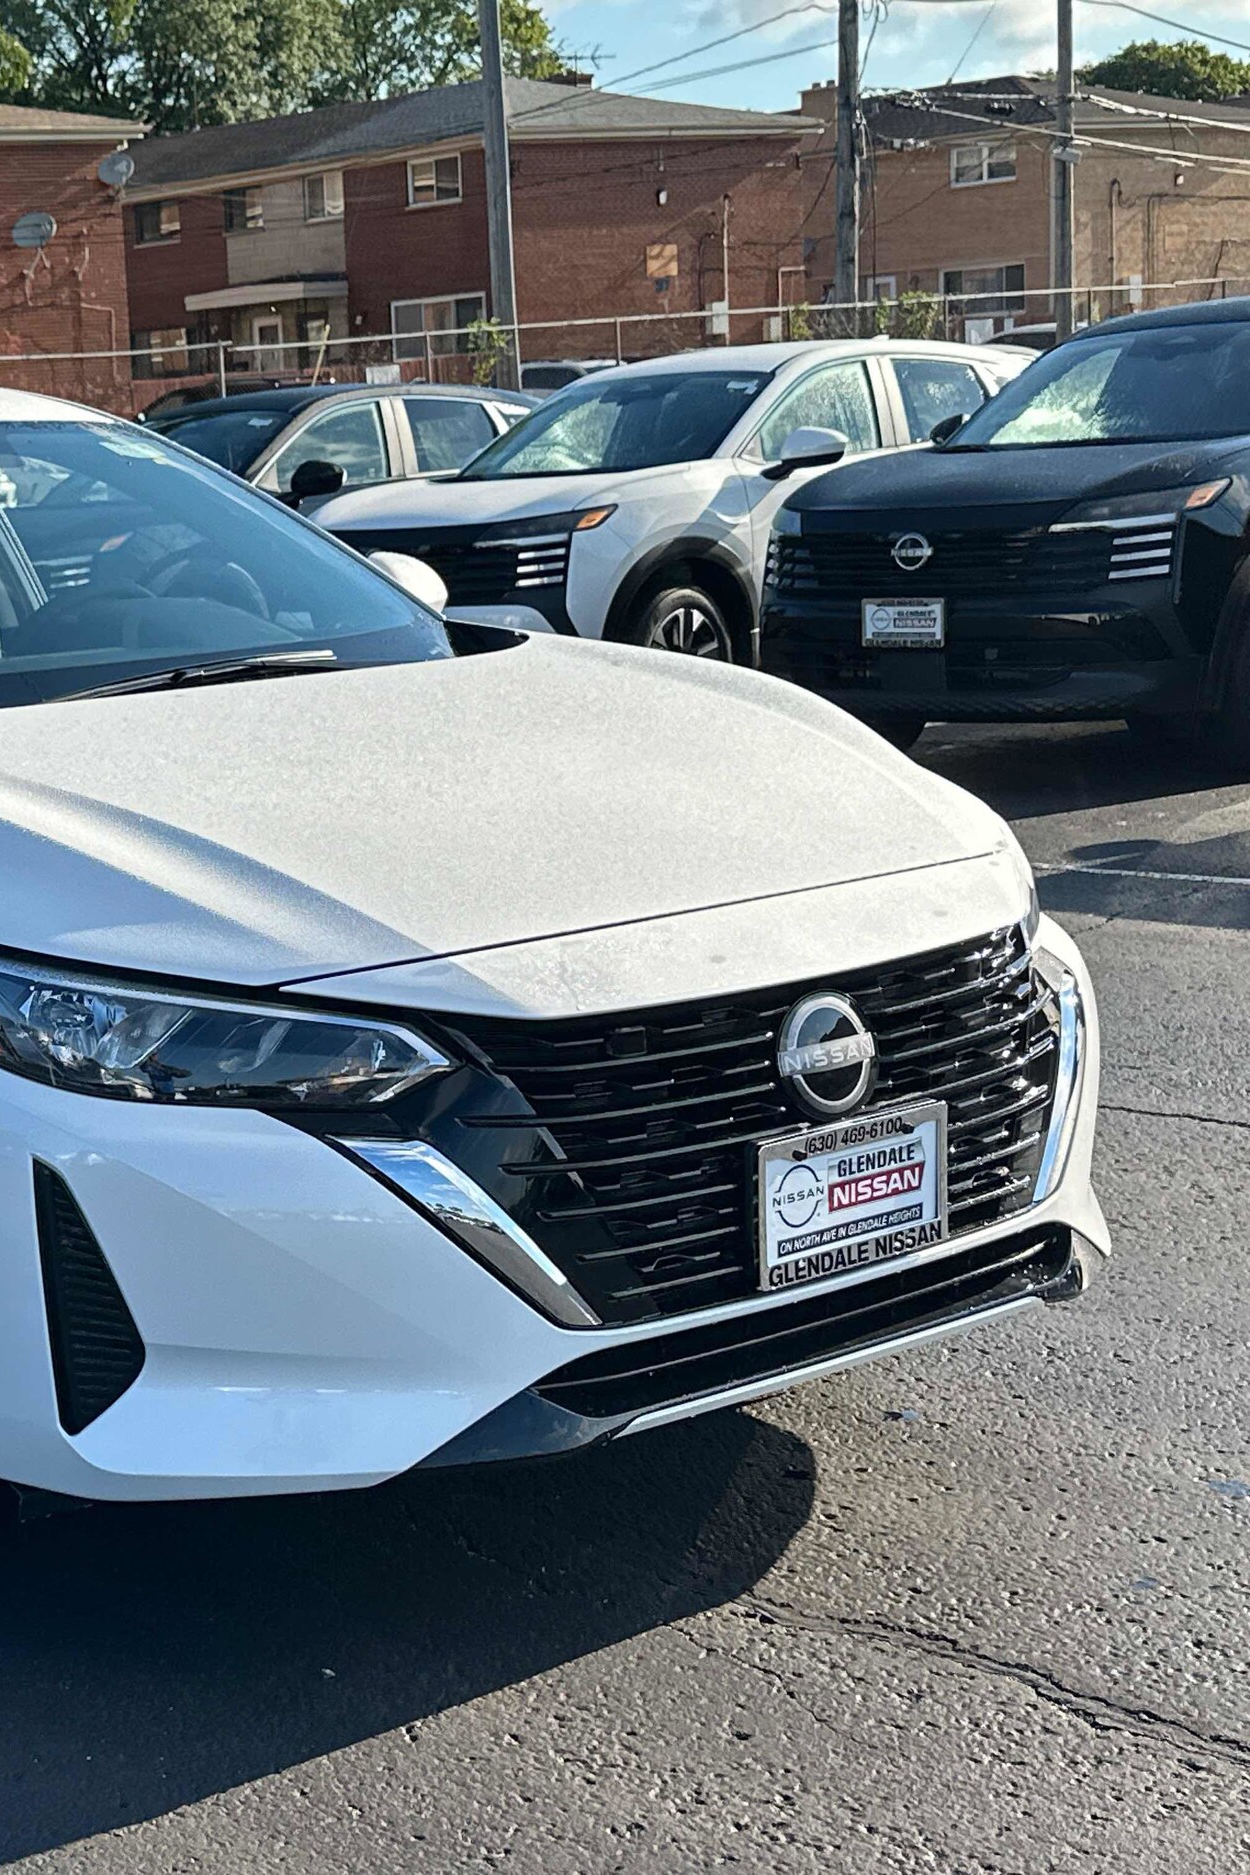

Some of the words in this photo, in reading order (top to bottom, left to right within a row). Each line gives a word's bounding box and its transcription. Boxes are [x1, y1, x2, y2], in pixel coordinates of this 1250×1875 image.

[783, 1038, 872, 1072] NISSAN
[805, 1131, 838, 1154] (630)
[841, 1116, 903, 1146] 469-6100
[837, 1143, 916, 1177] GLENDALE
[772, 1185, 825, 1208] NISSAN
[833, 1167, 920, 1208] NISSAN
[769, 1242, 869, 1287] GLENDALE
[875, 1220, 942, 1258] NISSAN
[779, 1242, 793, 1255] ON
[793, 1233, 821, 1251] NORTH
[821, 1228, 837, 1242] AVE
[837, 1226, 847, 1238] IN
[847, 1214, 888, 1235] GLENDALE
